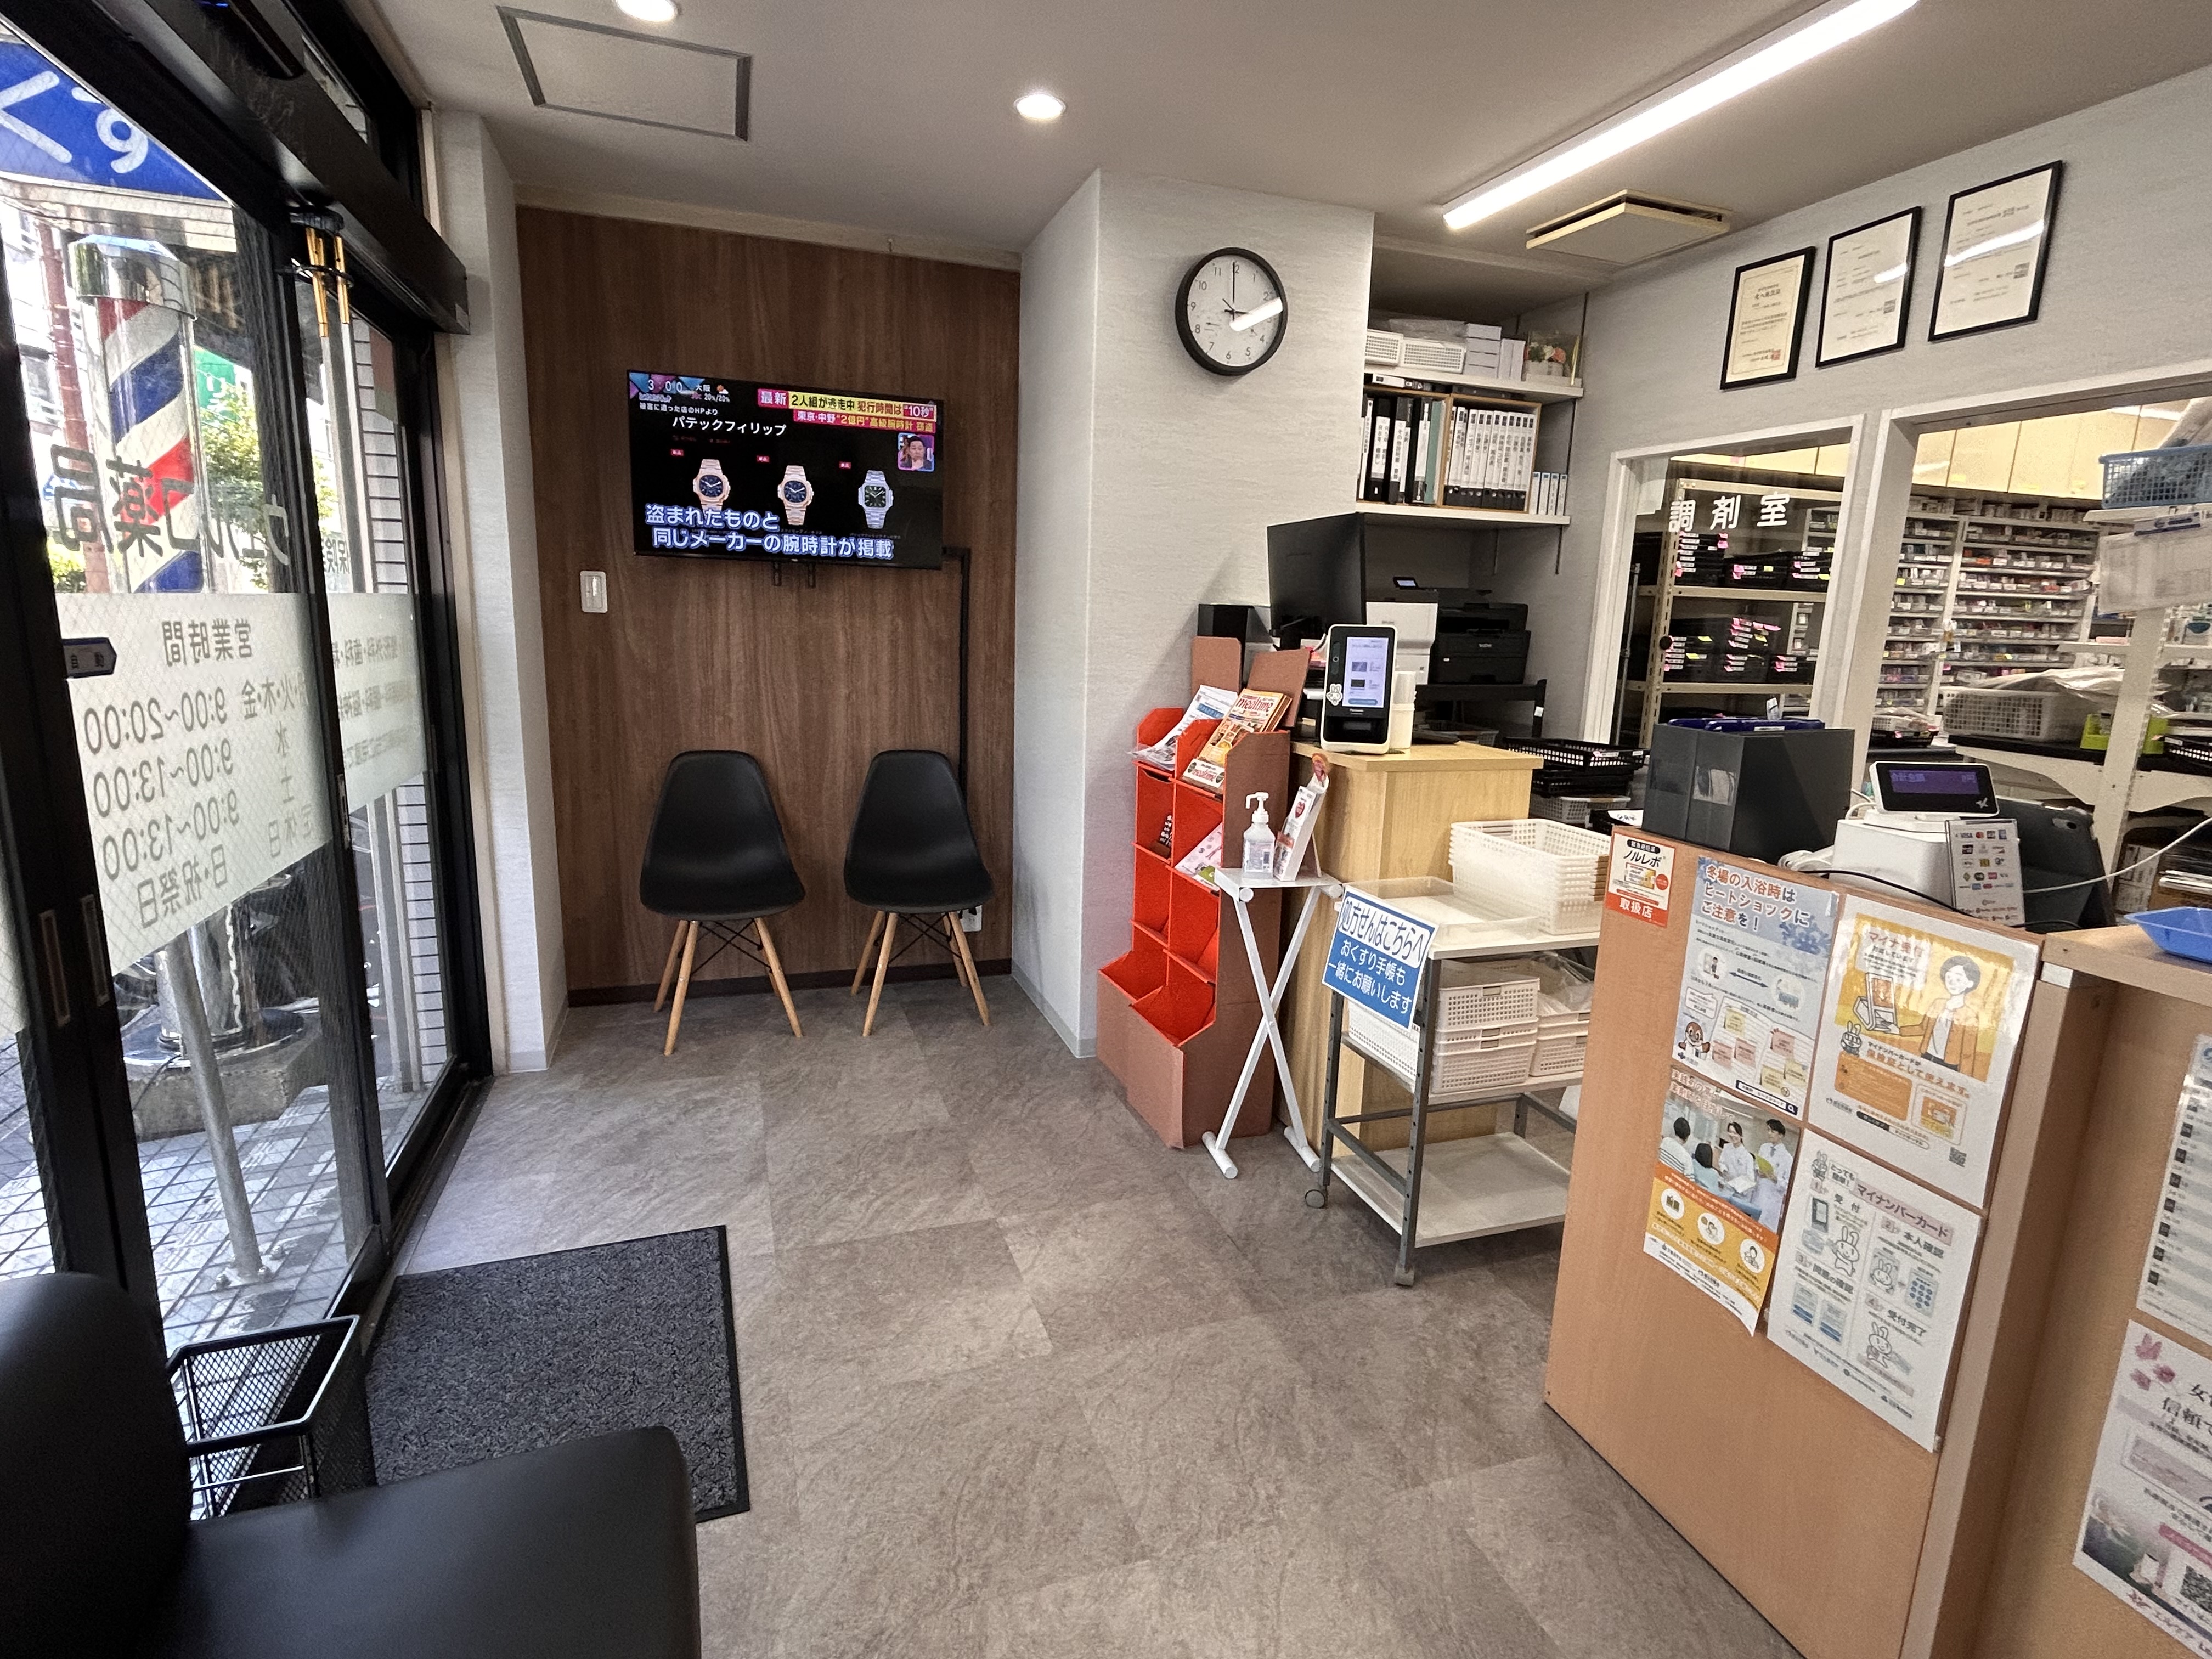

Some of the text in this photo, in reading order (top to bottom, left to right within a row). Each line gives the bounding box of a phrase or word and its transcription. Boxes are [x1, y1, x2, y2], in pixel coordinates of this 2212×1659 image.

[1214, 267, 1221, 276] 11
[1198, 280, 1207, 290] 10
[1190, 302, 1196, 311] 9
[1263, 291, 1269, 301] 2
[1195, 324, 1200, 334] 8
[1260, 335, 1265, 343] 4
[1209, 341, 1215, 351] 7
[1226, 351, 1232, 360] 6
[1245, 347, 1251, 357] 5
[760, 391, 787, 406] 最新
[791, 394, 855, 410] 2人組が逃走中
[857, 400, 902, 415] 犯行時間は
[672, 416, 787, 436] パテックフィリップ
[645, 504, 782, 531] 盗まれたものと
[1668, 492, 1791, 532] 調剤室
[652, 527, 895, 558] 同じメーカーの腕時計が掲載
[1235, 696, 1274, 712] mealtime
[1623, 848, 1662, 869] ノルレボ
[1705, 865, 1797, 905] 冬場の入浴時は
[1619, 896, 1653, 919] 取扱店
[1703, 882, 1810, 928] ヒートショックに
[1339, 898, 1424, 962] 処方せんはこちらへ
[1340, 939, 1406, 986] おくすり手帳も
[1328, 960, 1412, 1014] 一緒にお願いします
[1830, 1163, 1855, 1182] とっても
[1855, 1182, 1949, 1242] マイナンバーカード
[1903, 1230, 1944, 1261] 本人確認
[1887, 1308, 1926, 1340] 受付完了
